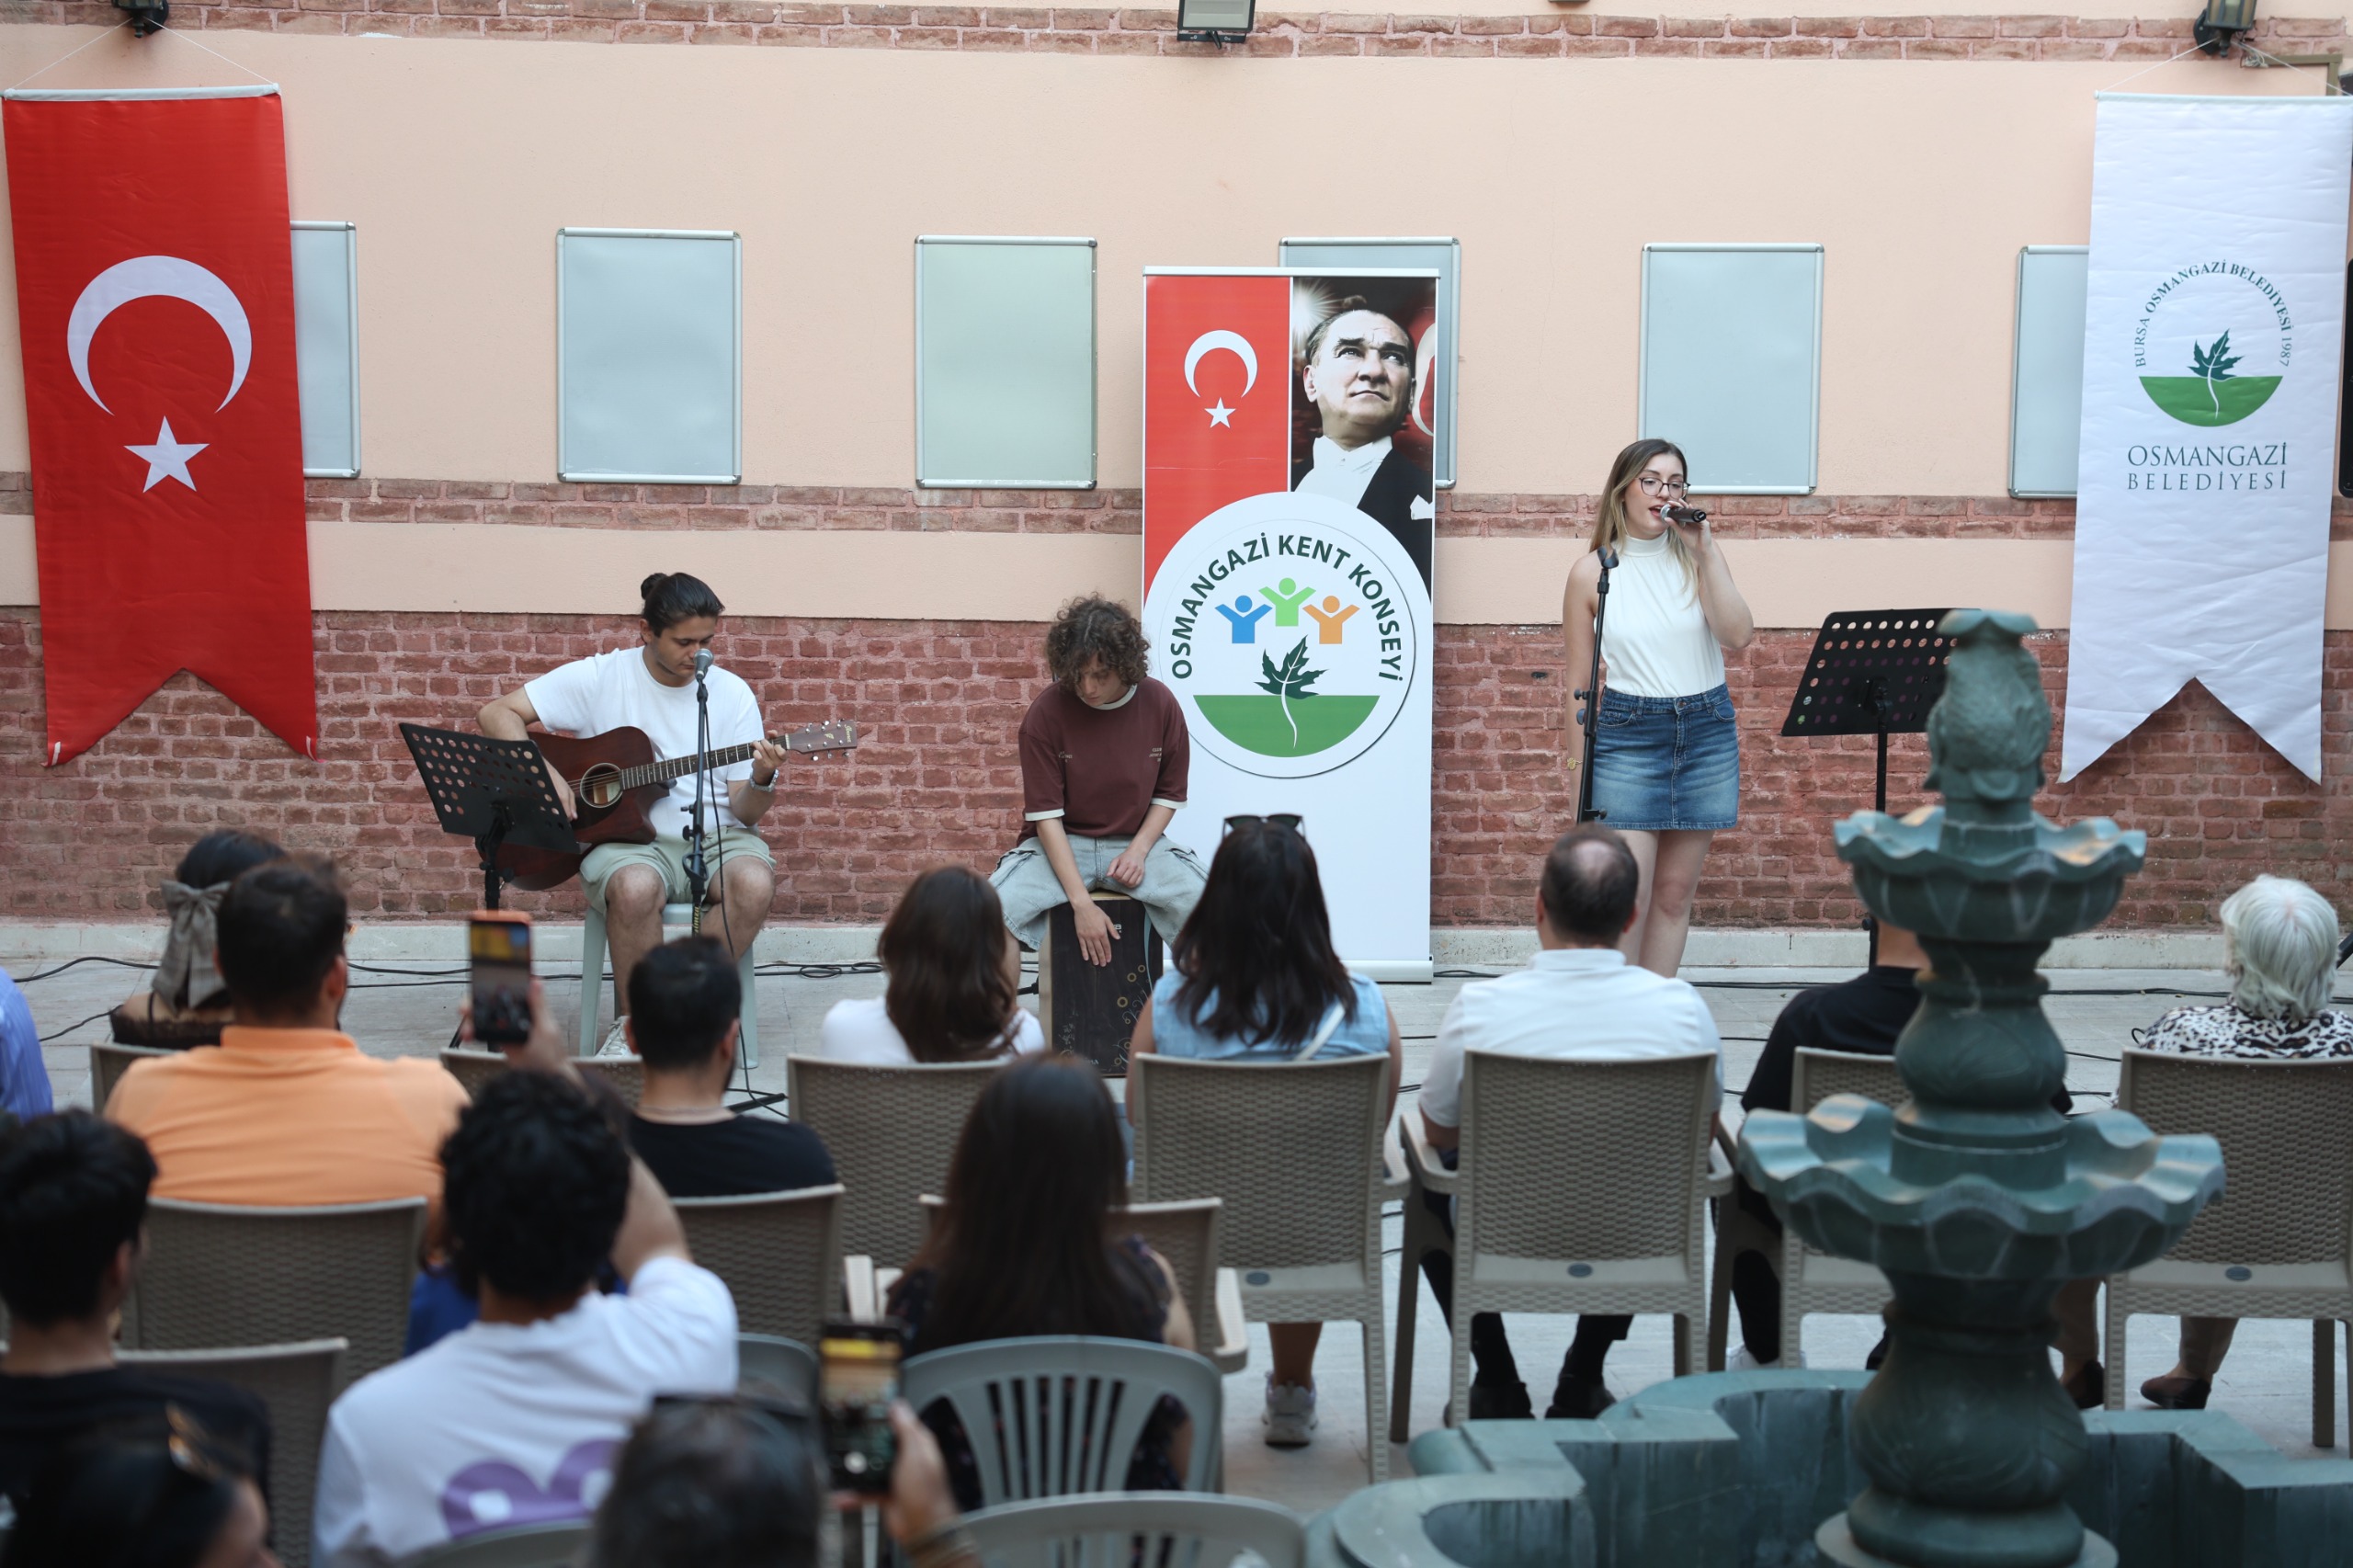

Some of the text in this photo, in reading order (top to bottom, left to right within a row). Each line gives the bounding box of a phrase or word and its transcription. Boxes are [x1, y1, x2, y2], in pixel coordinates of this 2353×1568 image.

[2133, 259, 2294, 368] BURSA OSMANGAZİ BELEDİYESİ 1987
[2127, 441, 2288, 467] OSMANGAZİ
[2127, 469, 2287, 491] BELEDİYESİ
[1170, 532, 1404, 682] OSMANGAZİ KENT KONSEYİ
